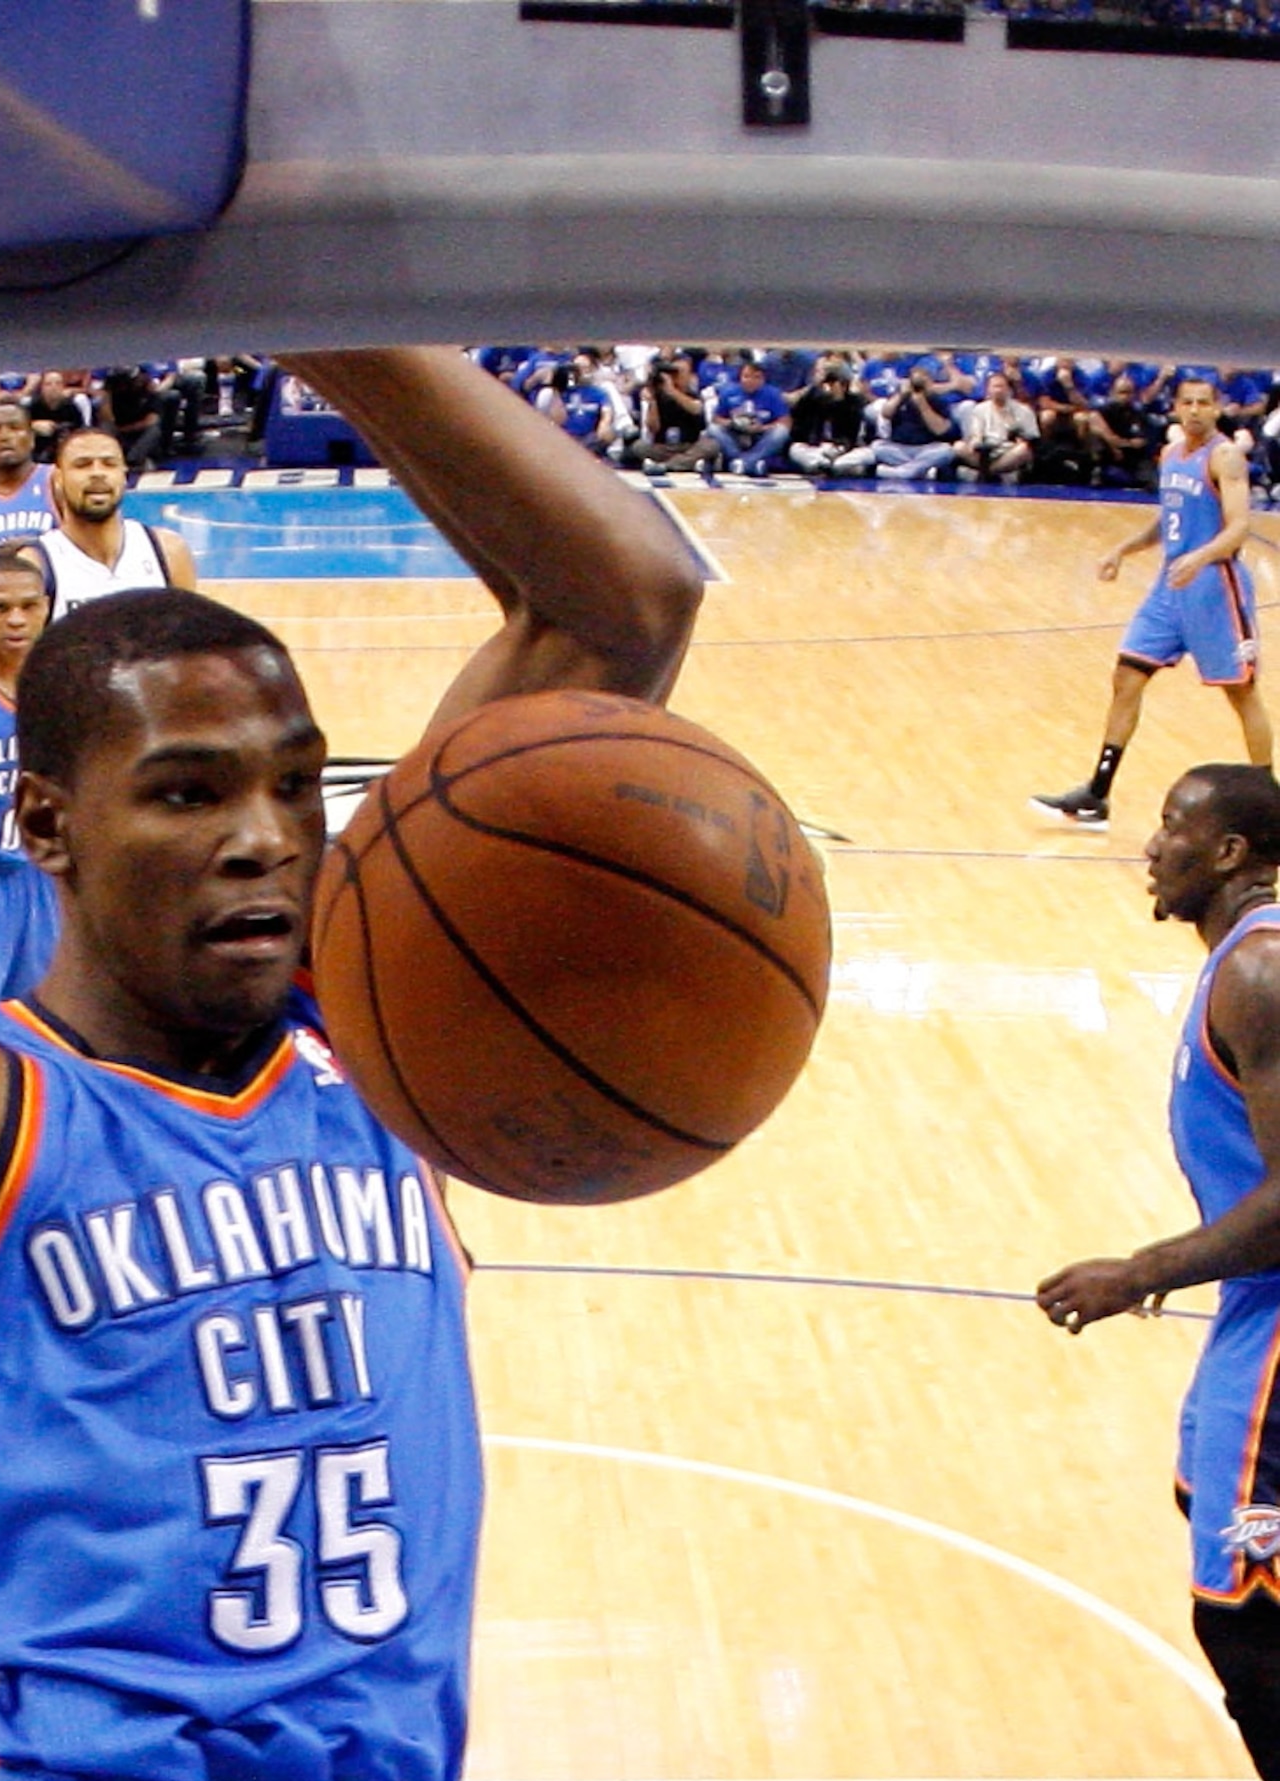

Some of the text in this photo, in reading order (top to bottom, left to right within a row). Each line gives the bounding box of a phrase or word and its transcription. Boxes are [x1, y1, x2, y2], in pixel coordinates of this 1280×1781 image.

[1168, 511, 1180, 541] 2
[29, 1159, 435, 1333] OKLAHOMA
[195, 1292, 374, 1422] CITY
[199, 1436, 410, 1655] 35
